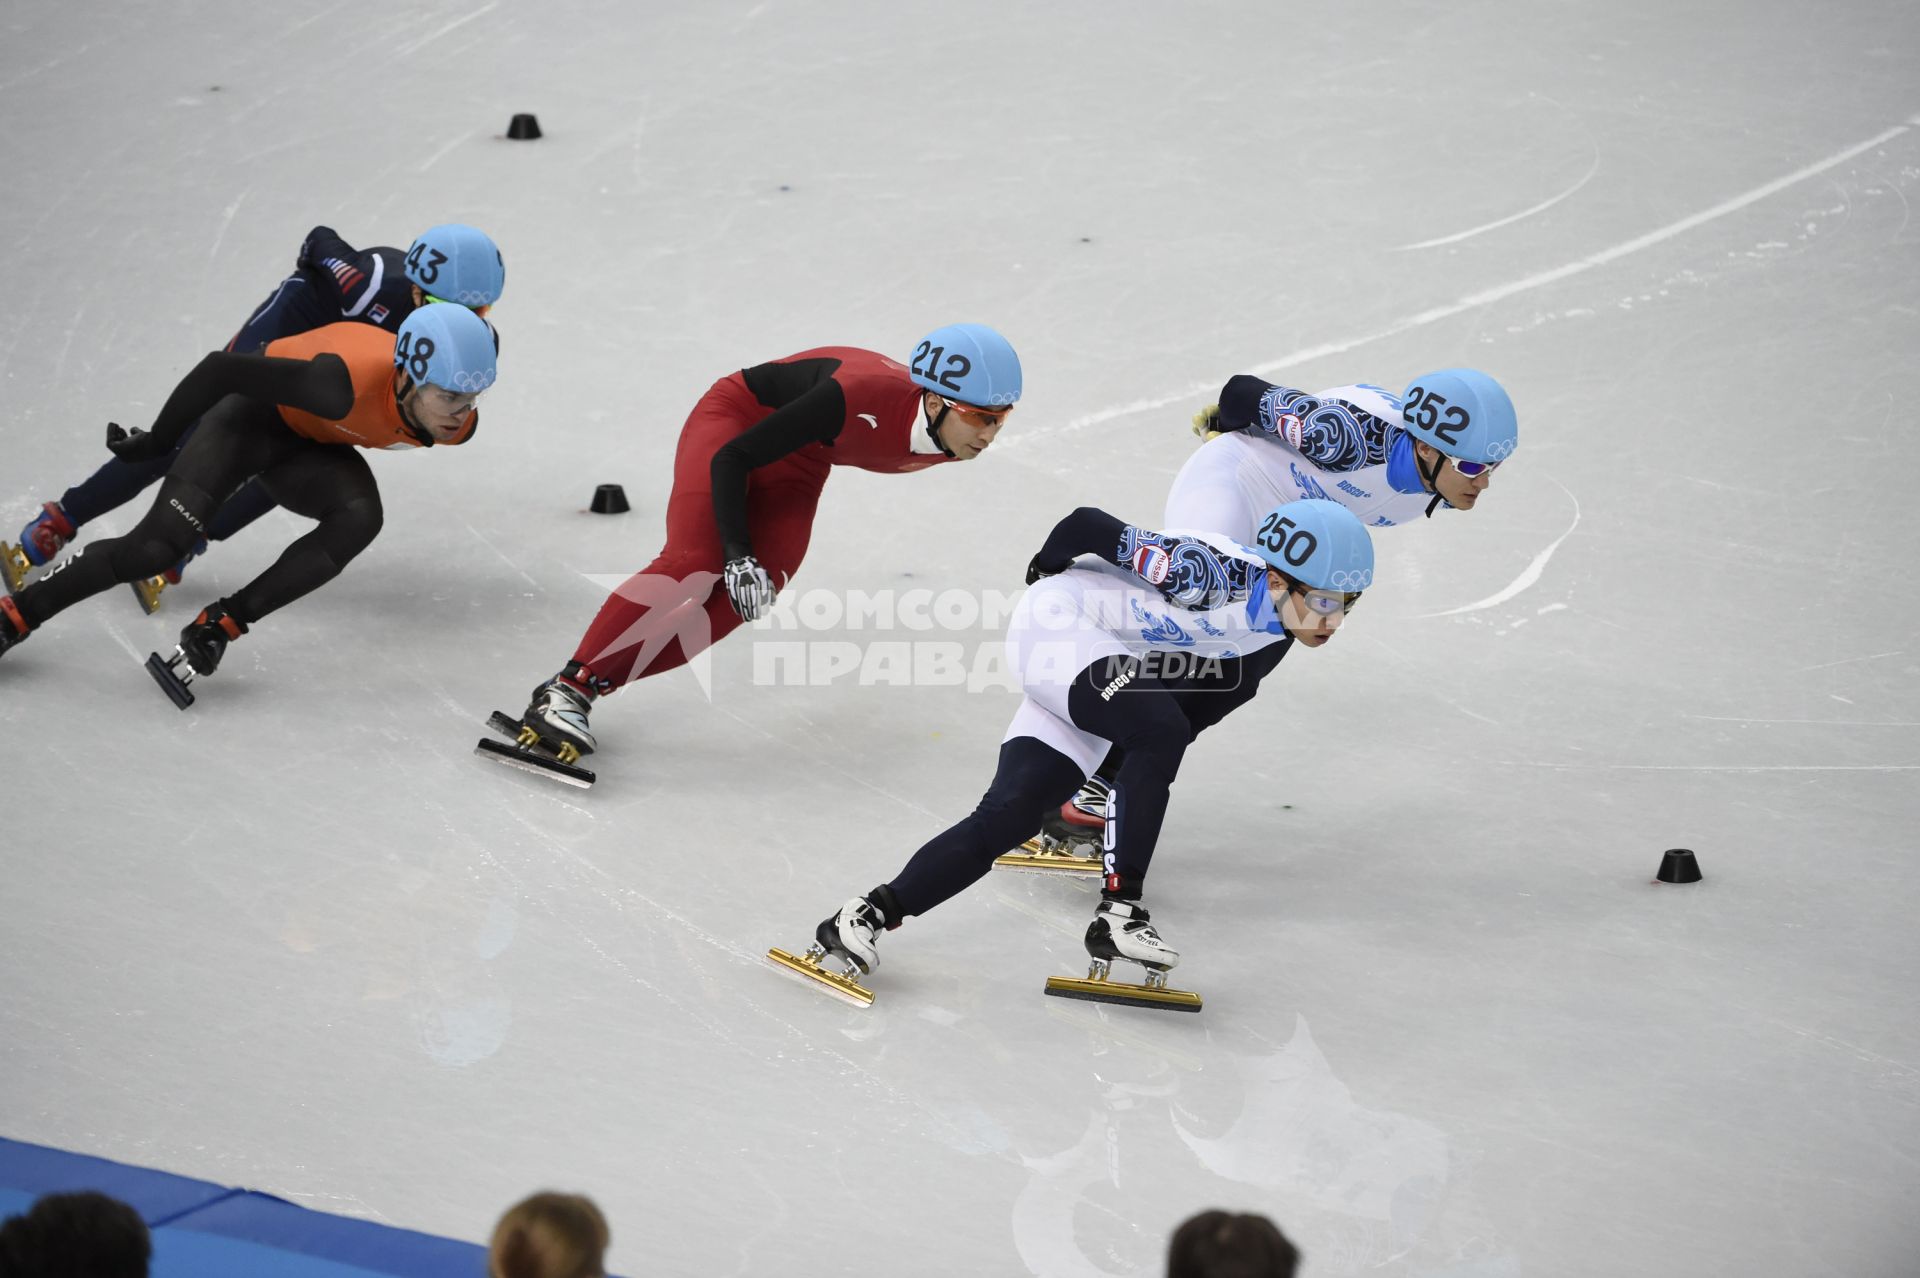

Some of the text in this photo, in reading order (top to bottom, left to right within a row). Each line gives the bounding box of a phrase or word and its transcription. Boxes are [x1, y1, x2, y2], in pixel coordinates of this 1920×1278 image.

[404, 240, 448, 285] 43
[394, 331, 435, 381] 48
[911, 340, 972, 392] 212
[1403, 386, 1470, 447] 252
[169, 498, 200, 526] CRAFT
[1336, 479, 1365, 498] BOSCO
[1256, 512, 1317, 567] 250
[1152, 554, 1166, 582] RUSSIA
[1100, 673, 1130, 702] BOSCO
[1103, 788, 1117, 874] RUS
